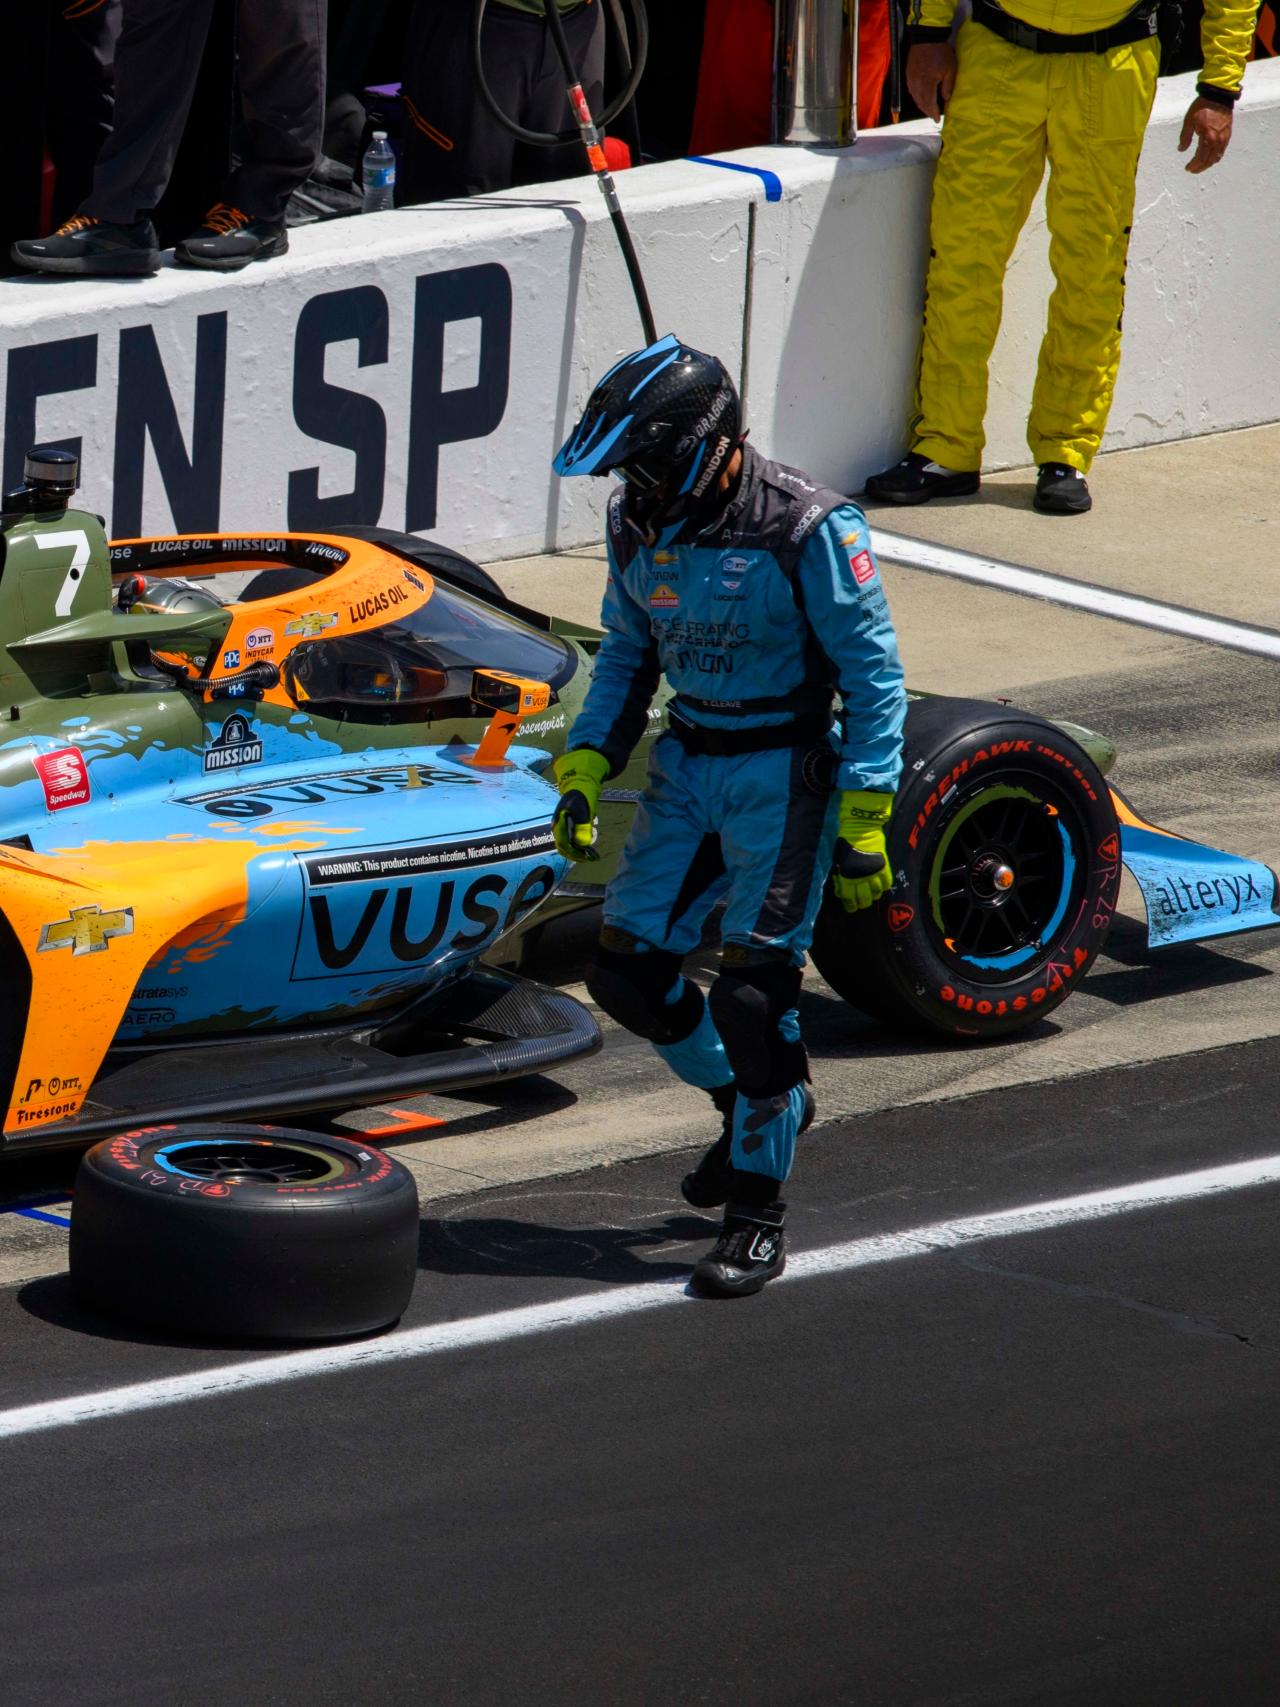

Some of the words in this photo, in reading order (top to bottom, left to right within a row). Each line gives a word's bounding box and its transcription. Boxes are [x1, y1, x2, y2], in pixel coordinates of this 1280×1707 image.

[286, 263, 512, 530] SP
[692, 436, 732, 498] BRENDON
[150, 540, 190, 553] LUCAS
[193, 539, 214, 550] OIL
[33, 529, 91, 617] 7
[349, 592, 390, 624] LUCAS
[388, 584, 409, 605] OIL
[224, 651, 240, 667] PPG
[245, 647, 274, 659] INDYCAR
[206, 744, 261, 769] MISSION
[50, 788, 87, 804] Speedway
[908, 739, 1034, 849] FIREHAWK
[318, 860, 363, 876] WARNING:
[363, 858, 380, 872] This
[381, 856, 409, 873] product
[409, 852, 439, 868] contains
[440, 850, 468, 863] nicotine.
[468, 847, 494, 859] Nicotine
[508, 838, 532, 852] addictive
[1156, 873, 1262, 915] alteryx
[939, 946, 1089, 1015] Firestone
[17, 1101, 76, 1125] Firestone
